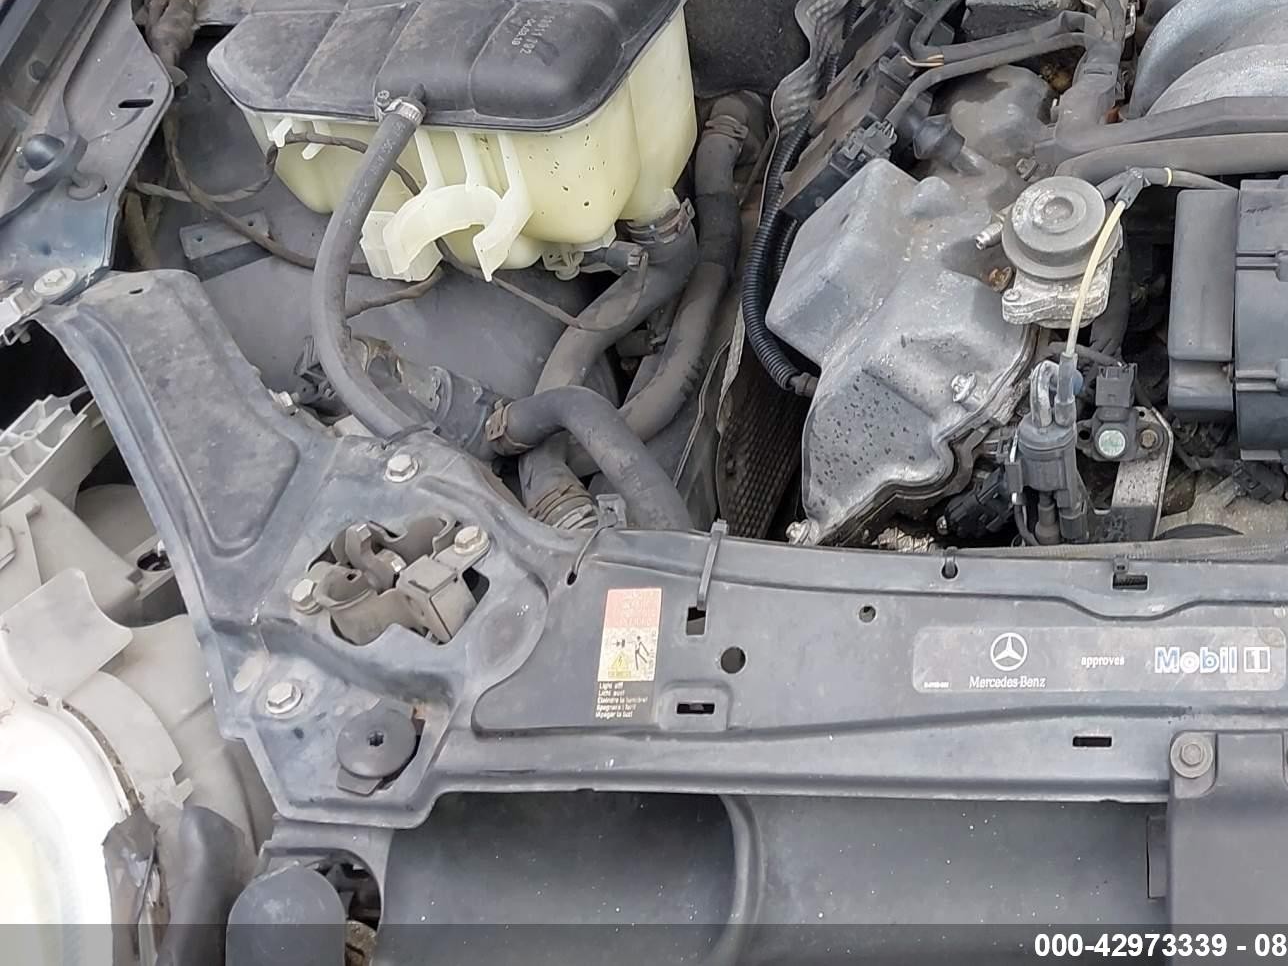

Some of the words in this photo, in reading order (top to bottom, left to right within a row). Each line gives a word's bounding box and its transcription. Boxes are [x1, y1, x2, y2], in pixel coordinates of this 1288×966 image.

[1081, 654, 1125, 668] approves
[1154, 646, 1238, 673] Mobil
[969, 674, 1046, 689] Mercedes-Benz
